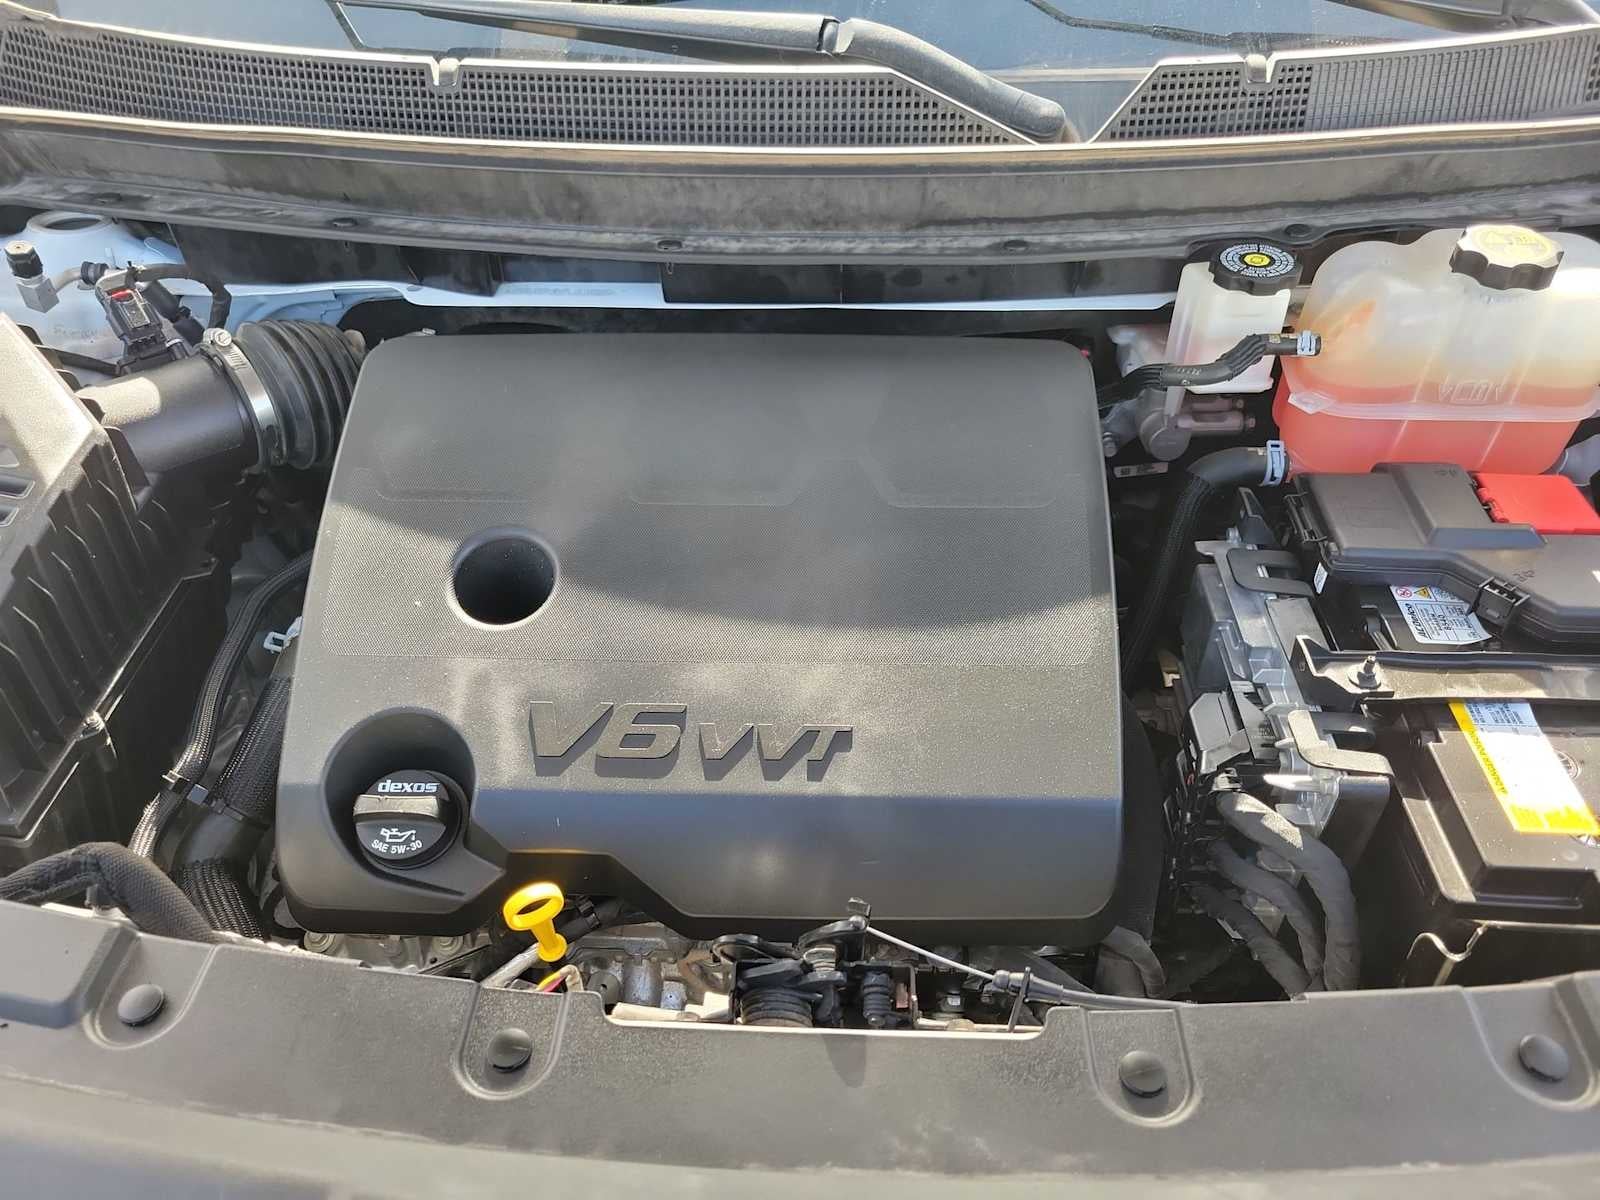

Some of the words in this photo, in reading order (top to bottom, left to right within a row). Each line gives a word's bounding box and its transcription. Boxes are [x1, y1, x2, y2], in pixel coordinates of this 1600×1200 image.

[529, 700, 687, 759] V6
[699, 724, 853, 762] VVT
[377, 780, 440, 793] dexos
[371, 839, 389, 853] SAE
[390, 840, 423, 854] 5W-30
